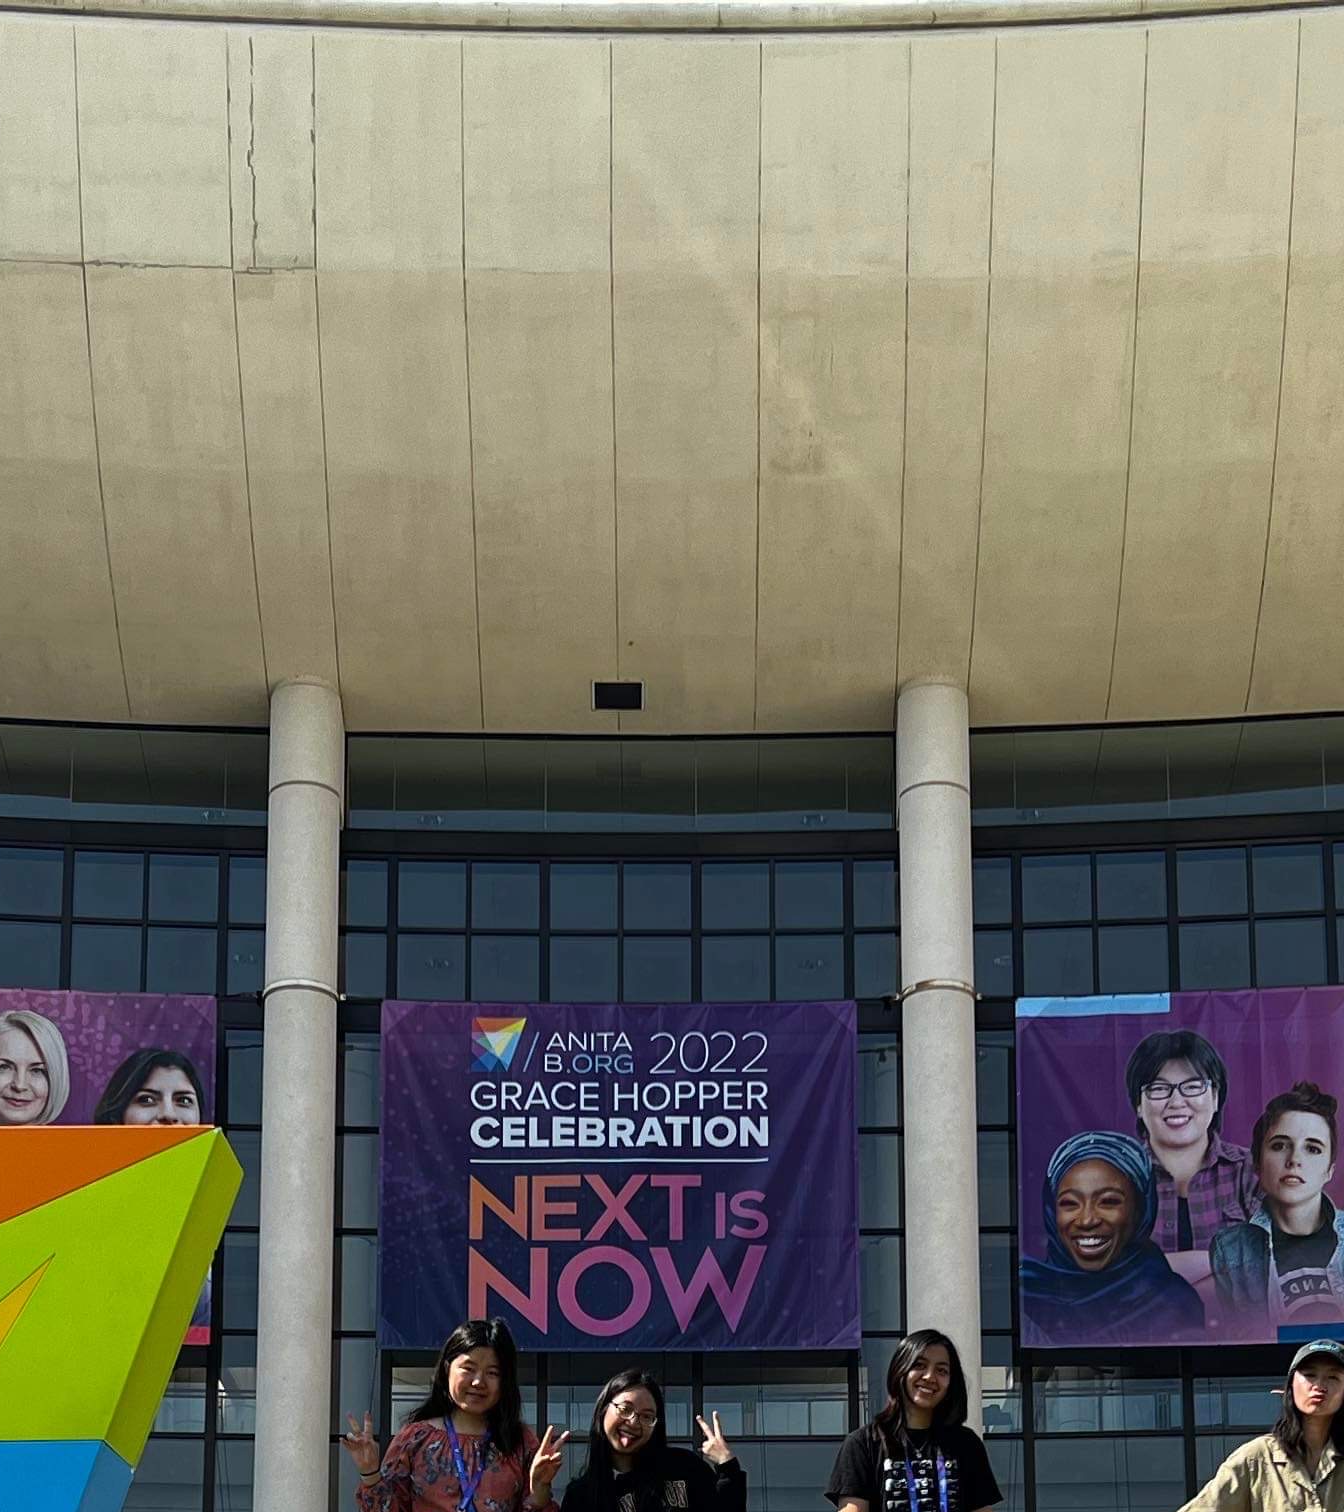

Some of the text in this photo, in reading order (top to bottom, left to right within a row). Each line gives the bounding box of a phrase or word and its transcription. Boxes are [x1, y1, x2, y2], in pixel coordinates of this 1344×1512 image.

[545, 1031, 633, 1053] ANITA
[650, 1030, 769, 1075] 2022
[544, 1054, 634, 1075] B.ORG
[470, 1081, 769, 1111] GRACE HOPPER
[470, 1115, 769, 1148] CELEBRATION
[468, 1173, 769, 1241] NEXT IS
[467, 1244, 768, 1337] NOW
